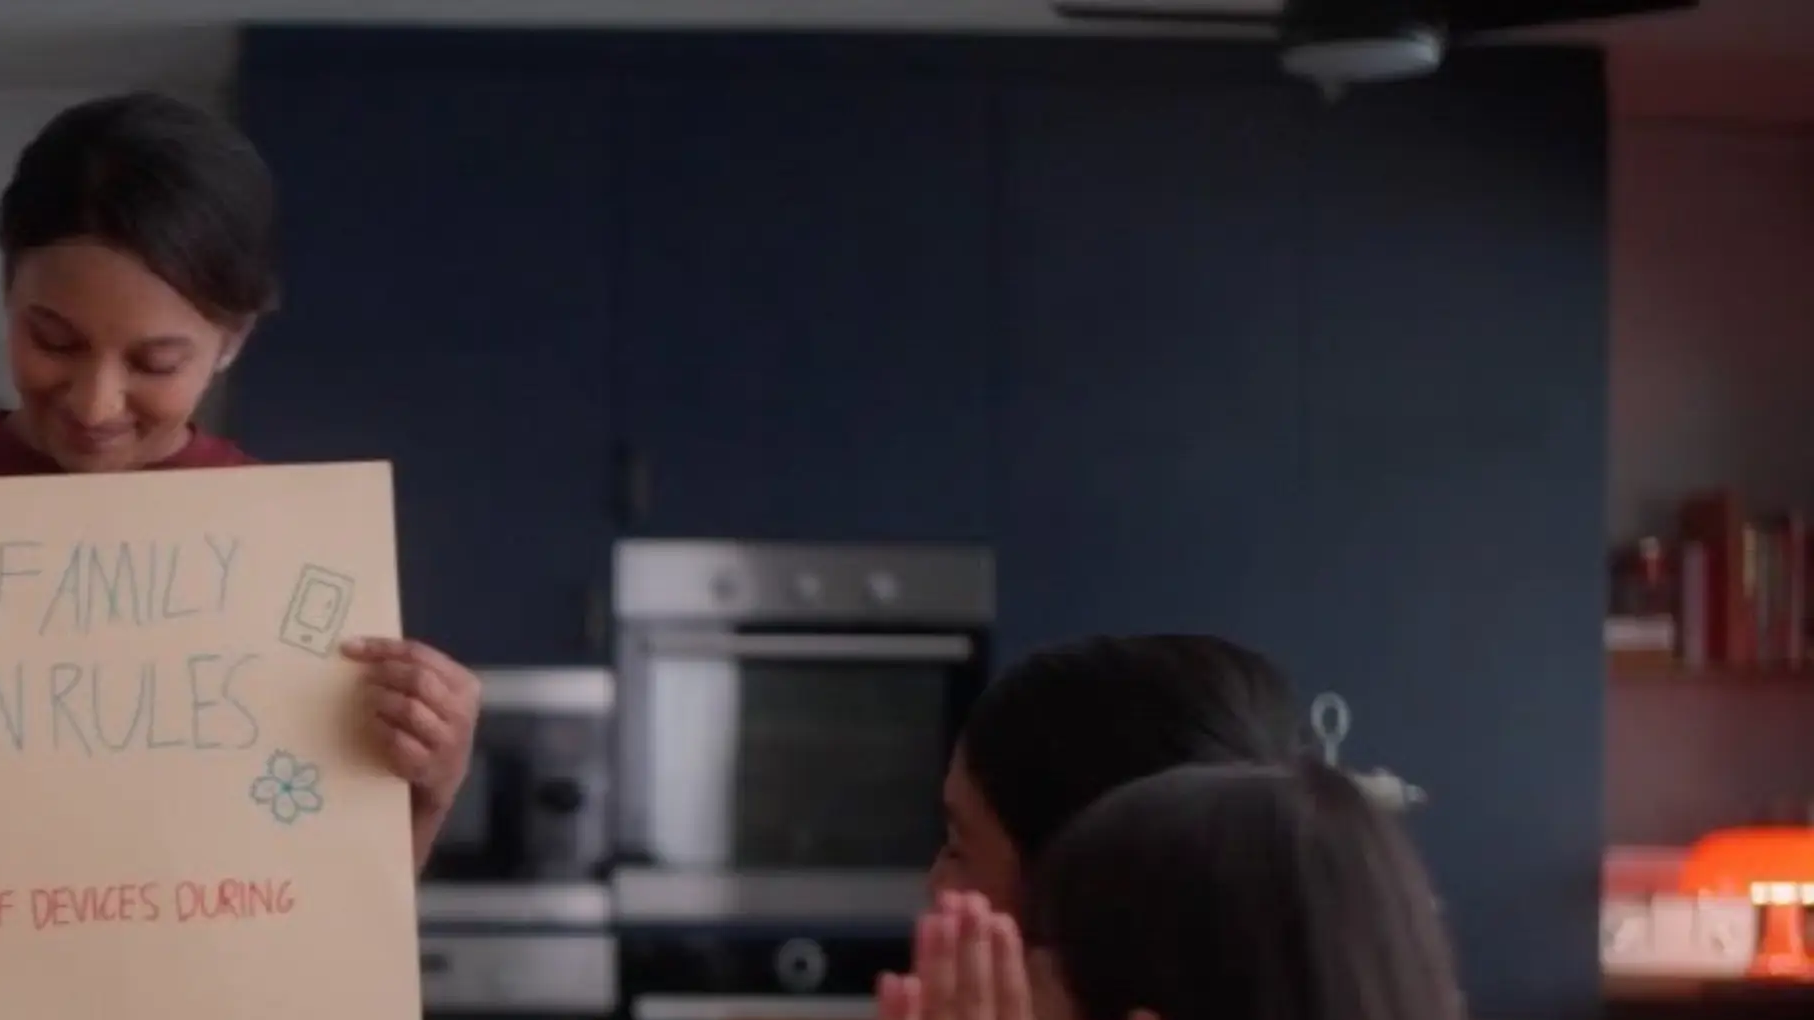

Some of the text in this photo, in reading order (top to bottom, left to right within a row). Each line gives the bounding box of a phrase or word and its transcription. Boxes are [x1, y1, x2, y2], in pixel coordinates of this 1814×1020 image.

[50, 653, 264, 758] RULES
[30, 881, 160, 930] DEVICES
[174, 877, 296, 922] DURING
